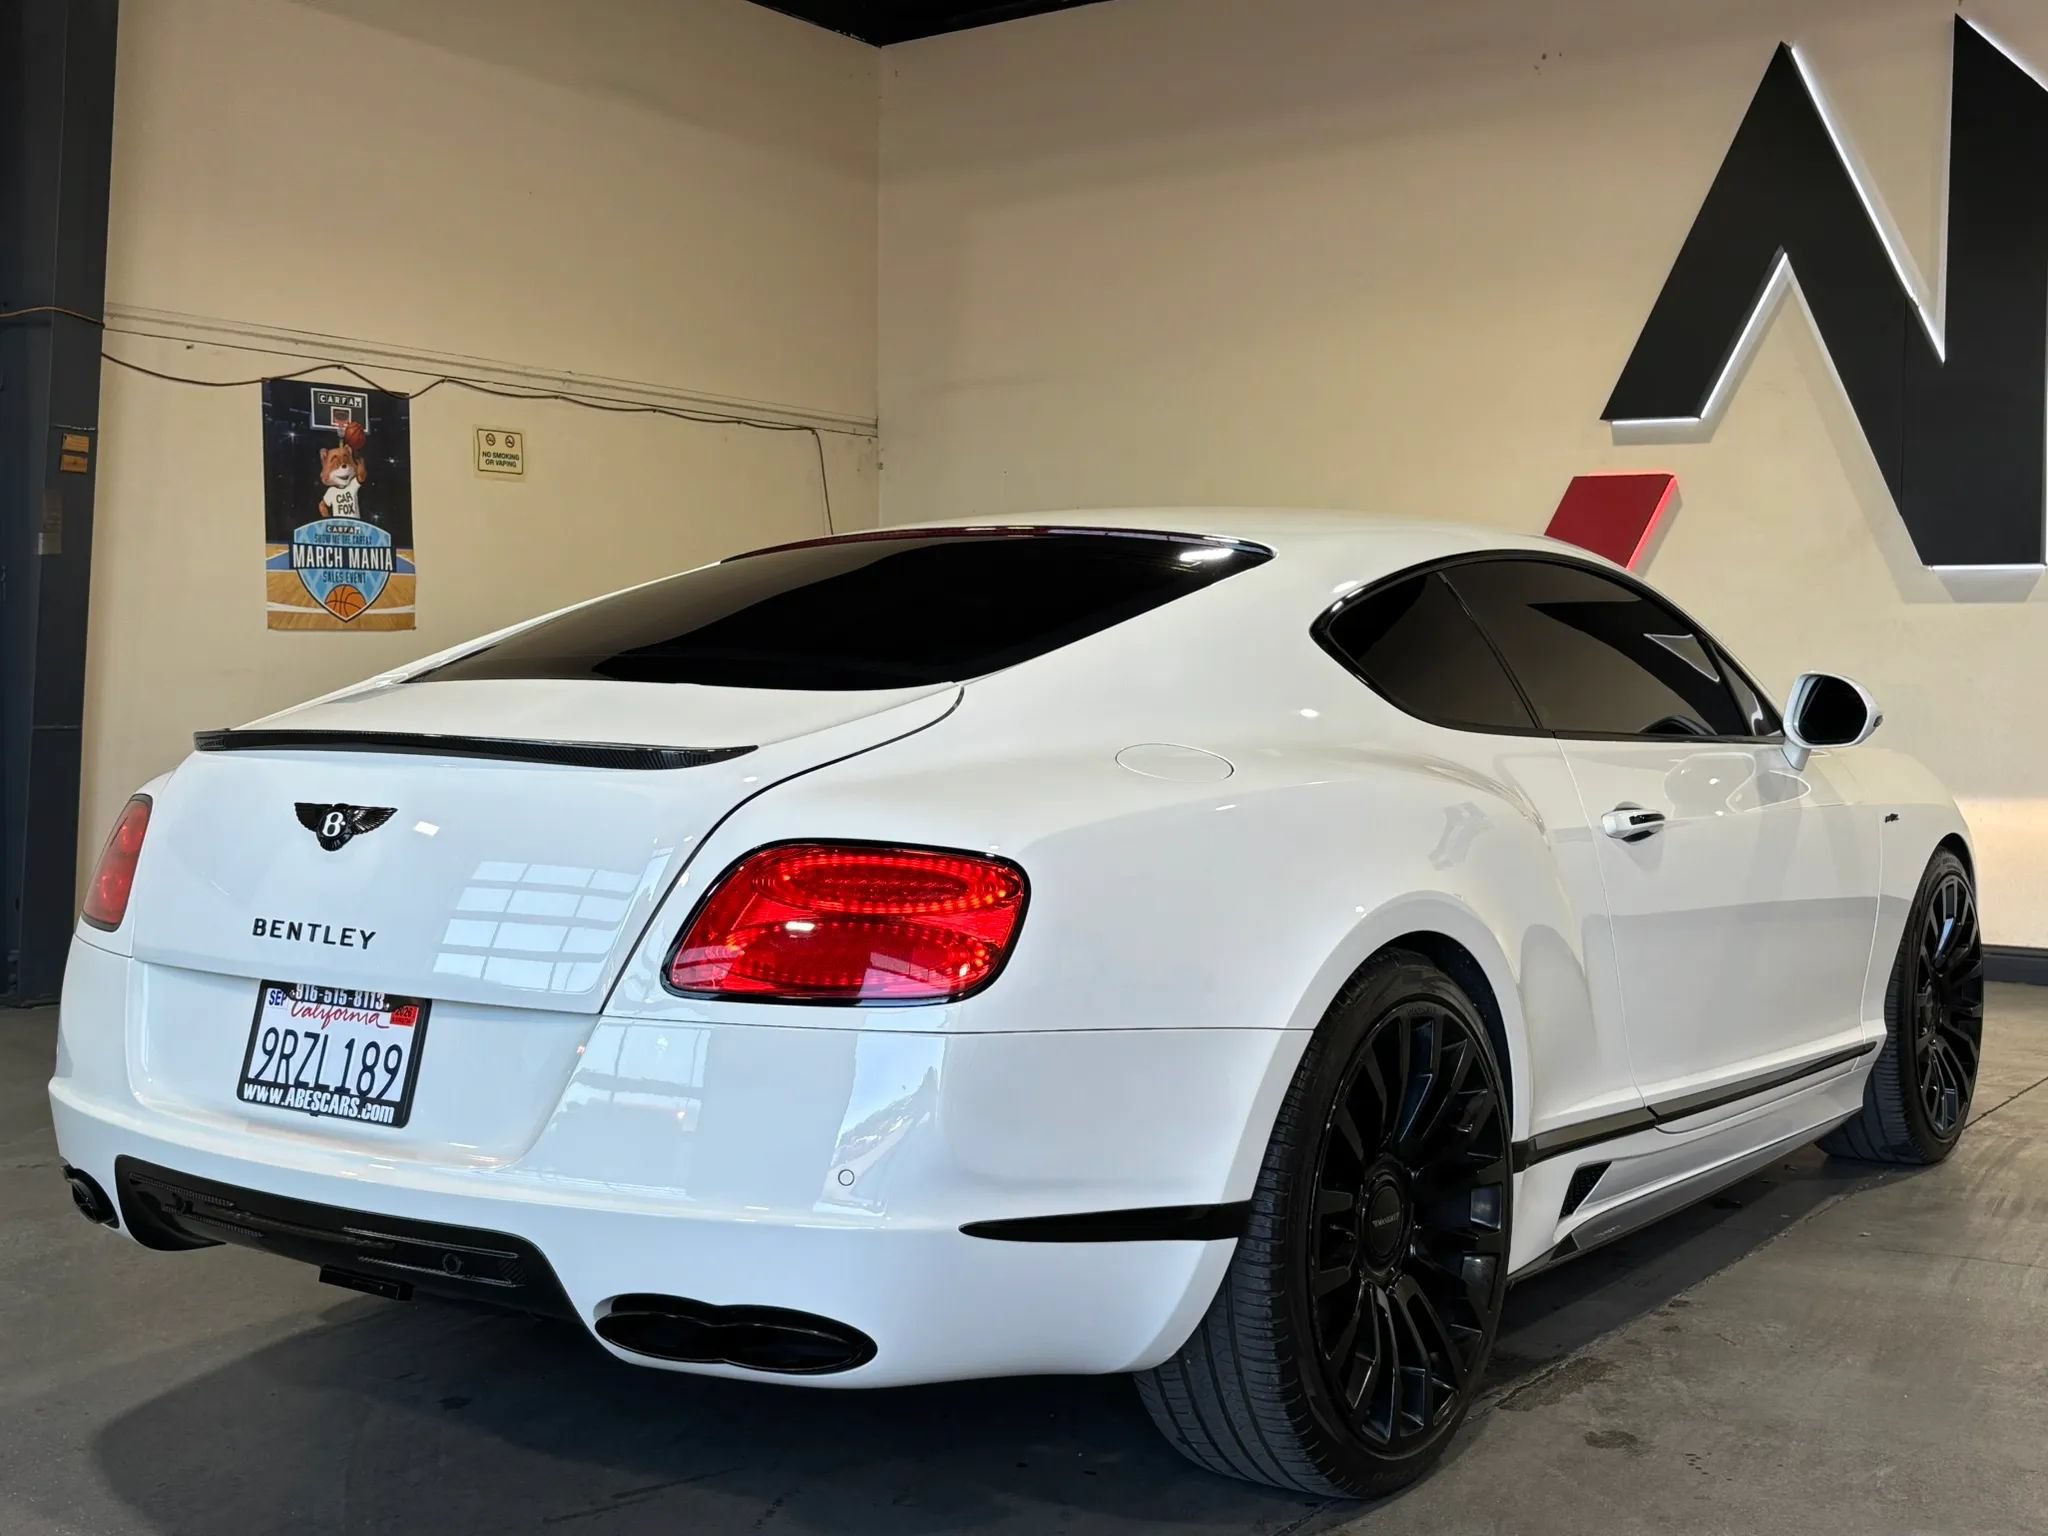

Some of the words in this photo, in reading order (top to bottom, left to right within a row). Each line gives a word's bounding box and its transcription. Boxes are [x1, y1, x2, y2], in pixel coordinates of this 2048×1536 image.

[319, 394, 362, 408] CARFAX
[493, 452, 519, 461] SMOKING
[496, 460, 517, 468] VAPING
[336, 491, 353, 503] CAR
[338, 503, 355, 514] FOX
[327, 525, 361, 535] CARFAX
[293, 545, 343, 568] MARCH
[348, 548, 393, 571] MANIA
[323, 571, 344, 583] SALES
[345, 572, 366, 584] EVENT
[252, 917, 377, 950] BENTLEY
[268, 990, 287, 1007] SEP
[290, 999, 390, 1030] California
[254, 1026, 403, 1099] 9RZL189
